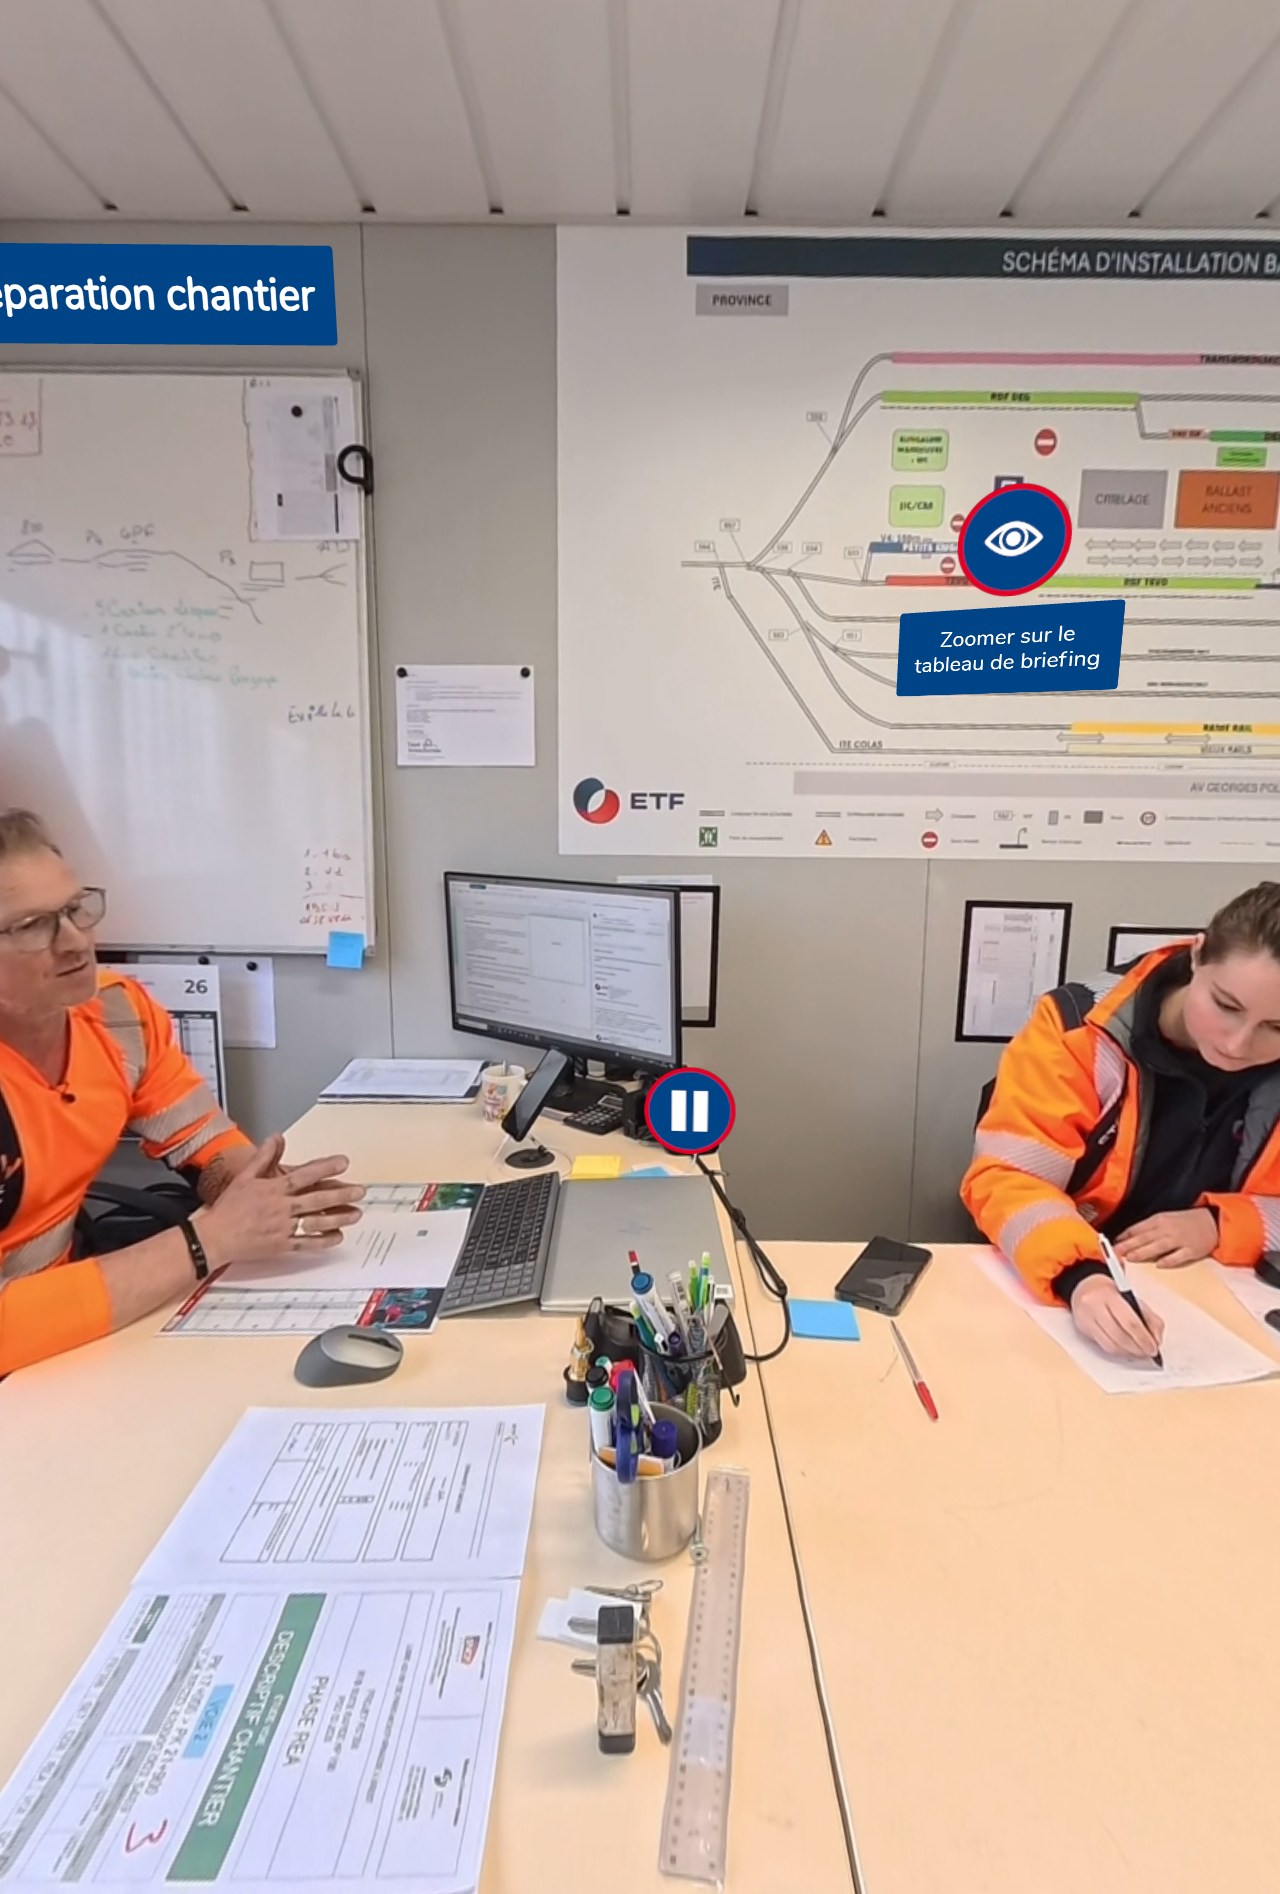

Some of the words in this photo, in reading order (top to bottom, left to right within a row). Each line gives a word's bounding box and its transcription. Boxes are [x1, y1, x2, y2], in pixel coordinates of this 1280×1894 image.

[1002, 247, 1091, 273] SCHÉMA
[1095, 251, 1260, 274] D'INSTALLATION
[711, 294, 772, 306] PROVINCE
[1205, 485, 1252, 498] BALLAST
[1207, 782, 1259, 794] GEORGES
[630, 793, 685, 810] ETF
[184, 979, 208, 994] 26
[239, 1630, 295, 1724] DESCRIPTIF
[296, 1676, 330, 1725] PHASE
[281, 1732, 310, 1766] REA
[196, 1729, 255, 1827] CHANTIER
